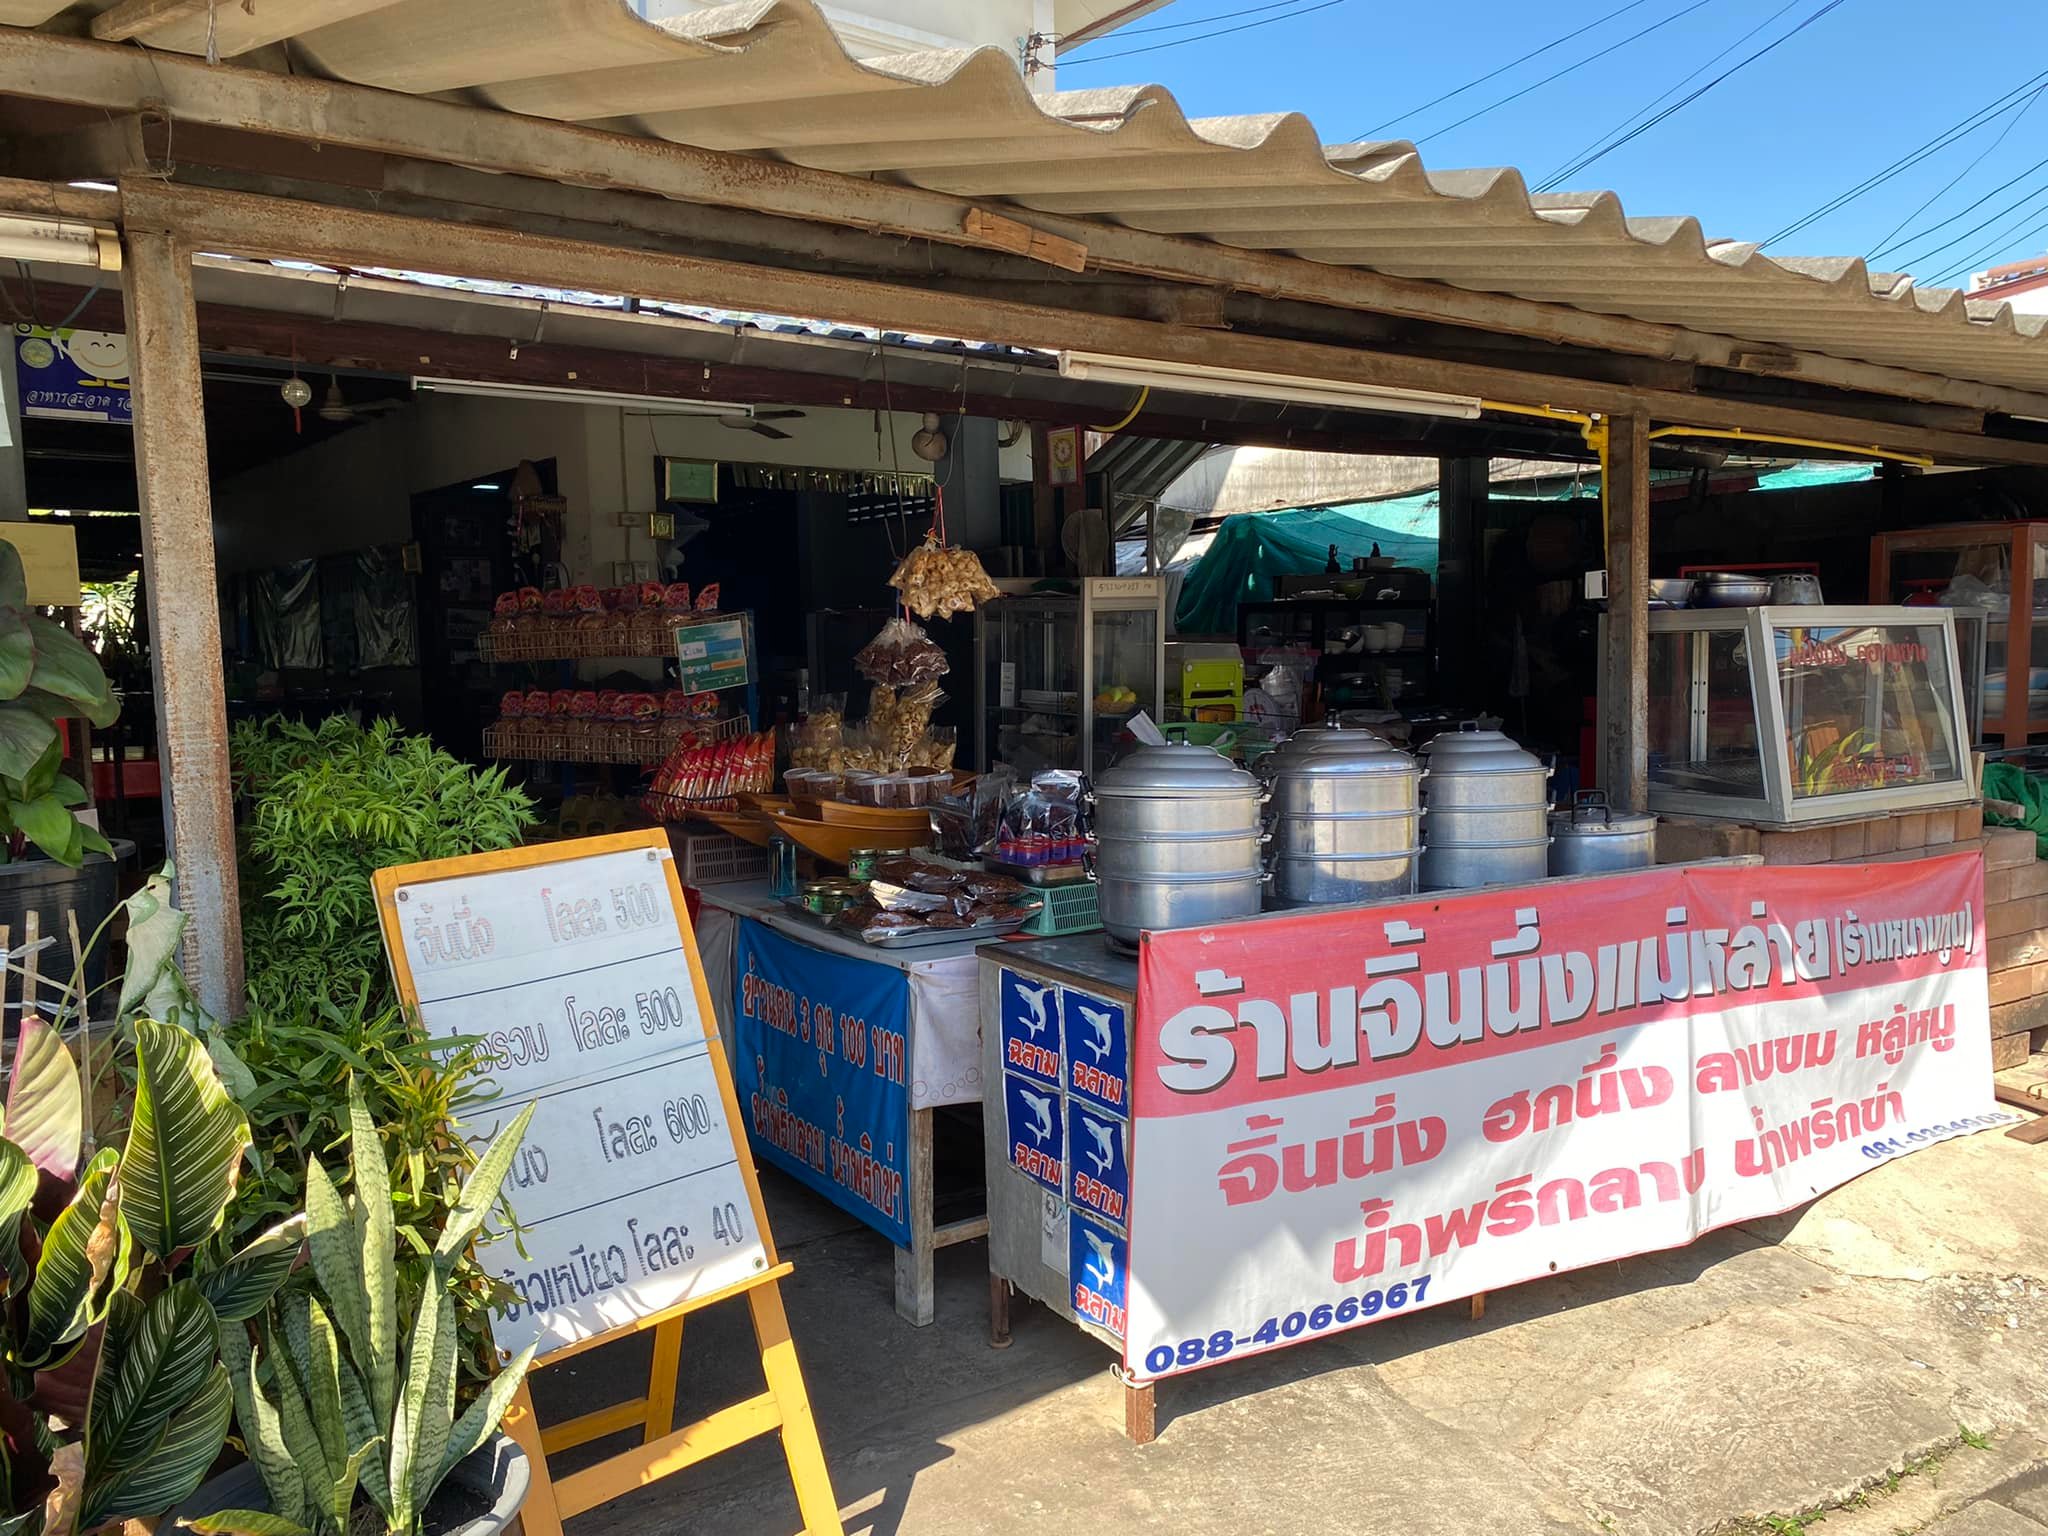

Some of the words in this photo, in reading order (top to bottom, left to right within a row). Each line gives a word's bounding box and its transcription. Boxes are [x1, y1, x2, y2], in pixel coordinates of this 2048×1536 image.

[540, 887, 606, 943] โลละ
[610, 882, 663, 926] 500
[565, 996, 630, 1052] โลละ
[637, 986, 683, 1036] 500
[800, 996, 811, 1043] 3
[840, 1013, 866, 1068] 100
[871, 1025, 905, 1087] บาท
[1007, 1037, 1058, 1078] ฉลาม
[1072, 1060, 1124, 1106] ฉลาม
[593, 1107, 658, 1163] โลละ
[663, 1094, 711, 1144] 600
[1217, 1092, 1447, 1207] จิ้นนึ่ง
[1696, 1029, 1837, 1095] ลาบขม
[1014, 1142, 1062, 1187] ฉลาม
[1074, 1172, 1124, 1220] ฉลาม
[1333, 1148, 1706, 1285] น้ำพริกลาบ
[1734, 1082, 1906, 1178] น้ำพริกข่า
[627, 1217, 695, 1277] โลละ
[712, 1202, 744, 1246] 40
[1074, 1282, 1126, 1339] ฉลาม
[1144, 1273, 1432, 1374] 088-4066967
